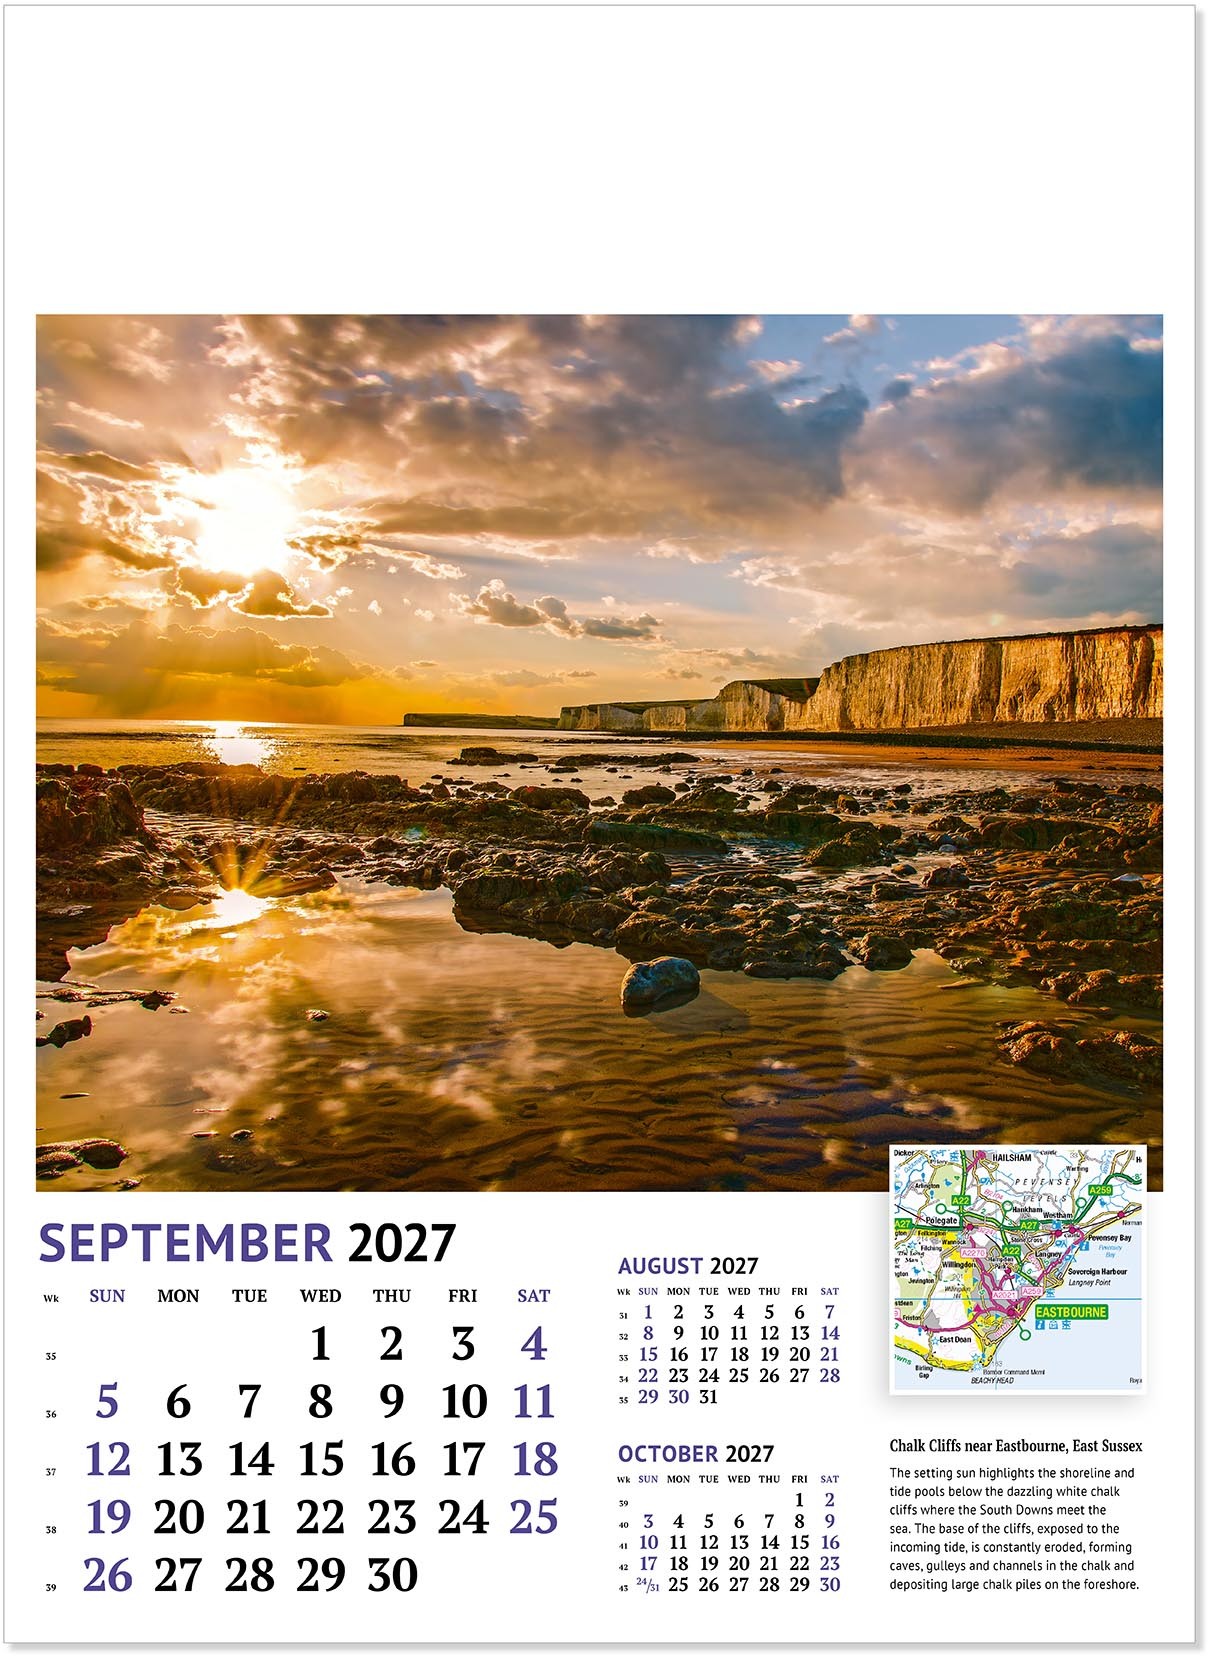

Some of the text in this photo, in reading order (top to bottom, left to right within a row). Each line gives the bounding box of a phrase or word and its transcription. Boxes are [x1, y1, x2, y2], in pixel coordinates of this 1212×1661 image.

[993, 1154, 1031, 1162] HAILSHAM
[926, 1216, 957, 1225] Polegate
[40, 1223, 456, 1262] SEPTEMBER 2027
[1035, 1251, 1062, 1259] Langney
[618, 1257, 758, 1274] AUGUST 2027
[942, 1261, 975, 1269] Willingdon
[1068, 1268, 1100, 1276] Sovereign
[1069, 1279, 1093, 1287] Langney
[90, 1289, 125, 1302] SUN
[158, 1289, 199, 1302] MON
[232, 1289, 267, 1302] TUE
[300, 1289, 341, 1302] WED
[373, 1289, 411, 1302] THU
[449, 1289, 477, 1302] FRI
[518, 1289, 550, 1302] SAT
[646, 1305, 651, 1319] 1
[674, 1305, 683, 1319] 2
[705, 1305, 713, 1319] 3
[734, 1305, 744, 1319] 4
[765, 1304, 774, 1319] 5
[795, 1305, 804, 1319] 6
[826, 1305, 834, 1319] 7
[1036, 1307, 1106, 1317] EASTBOURNE
[312, 1326, 330, 1360] 1
[380, 1326, 402, 1360] 2
[453, 1327, 474, 1360] 3
[521, 1326, 547, 1360] 4
[46, 1382, 554, 1418] 36 5 6 7 8 9 10 11
[890, 1439, 1142, 1454] Chalk Cliffs near Eastbourne, East Sussex
[619, 1445, 774, 1462] OCTOBER 2027
[890, 1468, 1134, 1481] The setting sun highlights the shoreline and
[890, 1486, 1119, 1499] tide pools below the dazzling white chalk
[796, 1493, 803, 1507] 1
[825, 1493, 834, 1506] 2
[890, 1504, 1106, 1515] cliffs where the South Downs meet the
[890, 1523, 1119, 1536] sea. The base of the cliffs, exposed to the
[891, 1541, 1131, 1555] incoming tide, is constantly eroded, forming
[641, 1557, 657, 1570] 17
[670, 1556, 688, 1571] 18
[701, 1556, 718, 1570] 19
[729, 1556, 749, 1571] 20
[760, 1556, 778, 1570] 21
[790, 1556, 809, 1570] 22
[820, 1556, 839, 1570] 23
[890, 1560, 1134, 1573] caves, gulleys and channels in the chalk and
[84, 1558, 132, 1591] 26
[155, 1558, 202, 1591] 27
[225, 1558, 274, 1592] 28
[297, 1558, 345, 1592] 29
[368, 1558, 417, 1592] 30
[890, 1579, 1139, 1592] depositing large chalk piles on the foreshore.
